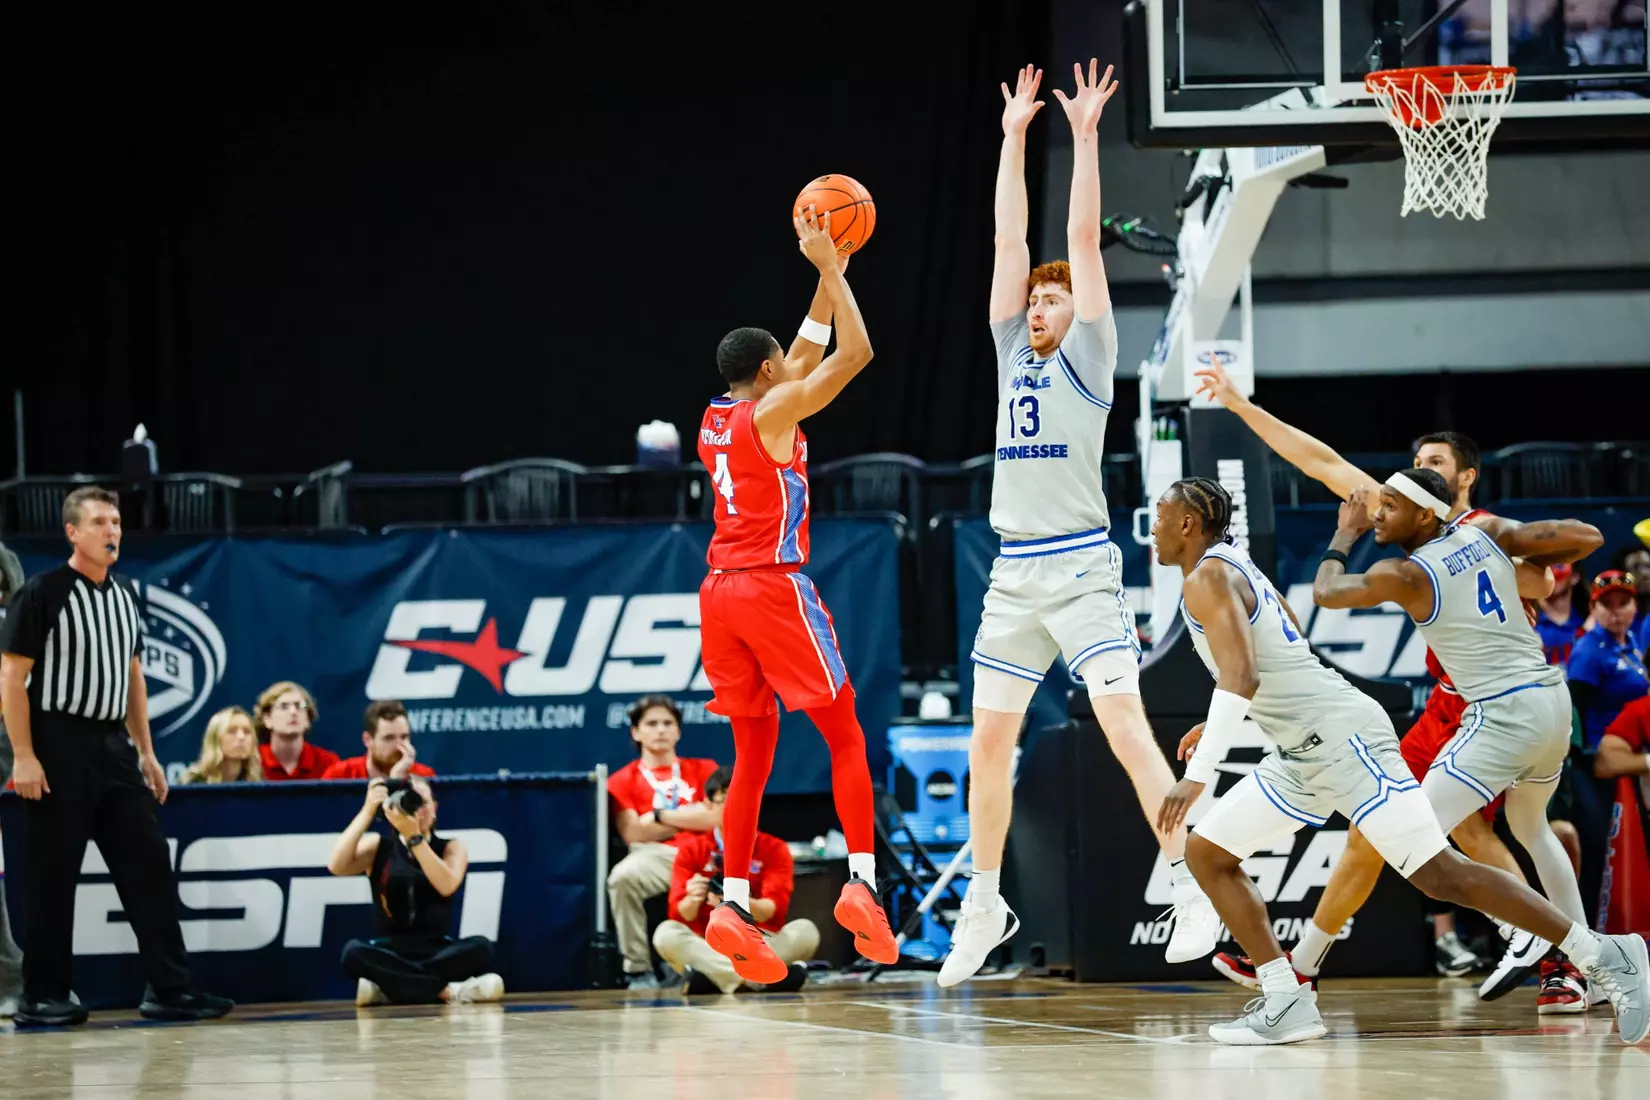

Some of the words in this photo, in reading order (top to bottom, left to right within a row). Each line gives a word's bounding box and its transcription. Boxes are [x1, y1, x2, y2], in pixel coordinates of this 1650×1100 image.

[1009, 395, 1040, 439] 13
[997, 444, 1068, 461] TENNESSEE
[713, 453, 738, 515] 4
[1477, 569, 1506, 624] 4
[407, 704, 585, 735] NFERENCEUSA.COM
